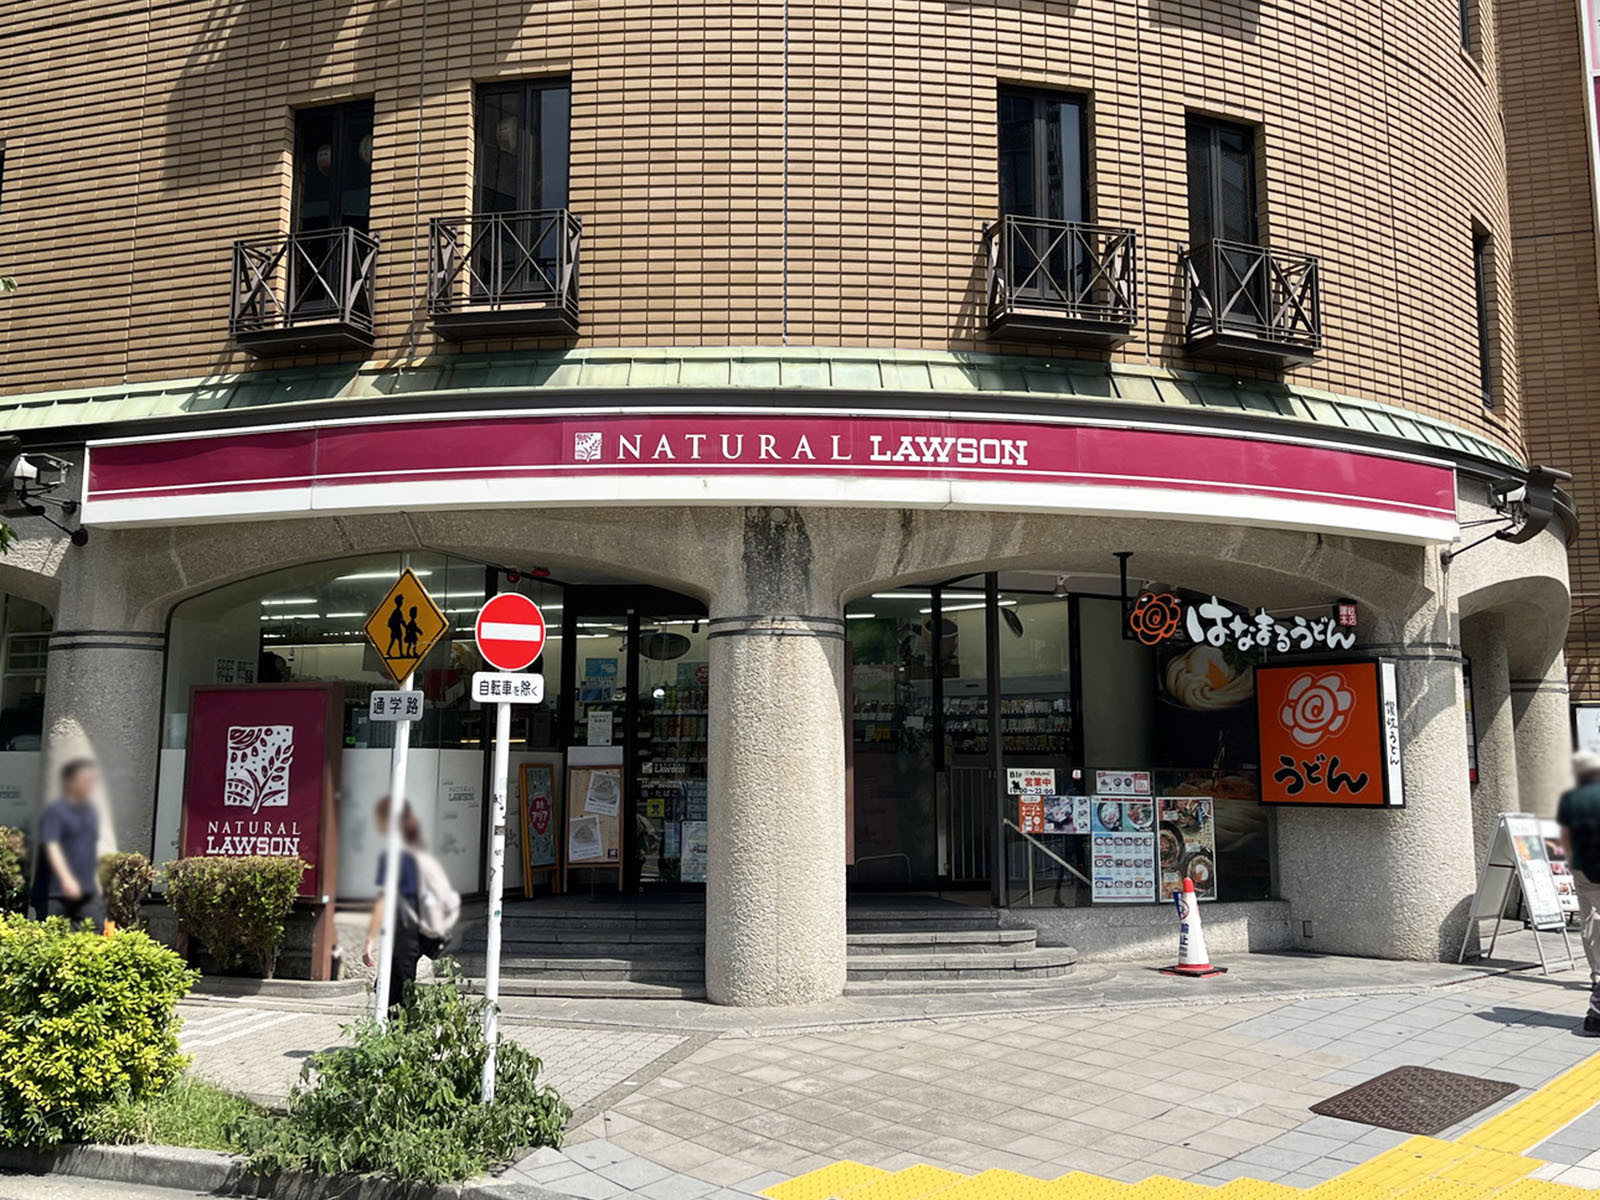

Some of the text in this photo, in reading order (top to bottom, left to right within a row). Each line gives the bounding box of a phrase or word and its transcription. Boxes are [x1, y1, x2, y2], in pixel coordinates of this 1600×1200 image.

[617, 433, 1028, 466] NATURAL LAWSON
[1186, 595, 1356, 652] はなまるうどん
[479, 680, 538, 697] 自転車を除く
[373, 697, 419, 715] 通学路
[1024, 777, 1051, 787] 営業中
[1273, 754, 1370, 794] うどん
[208, 821, 301, 835] NATURAL
[206, 836, 300, 855] LAWSON
